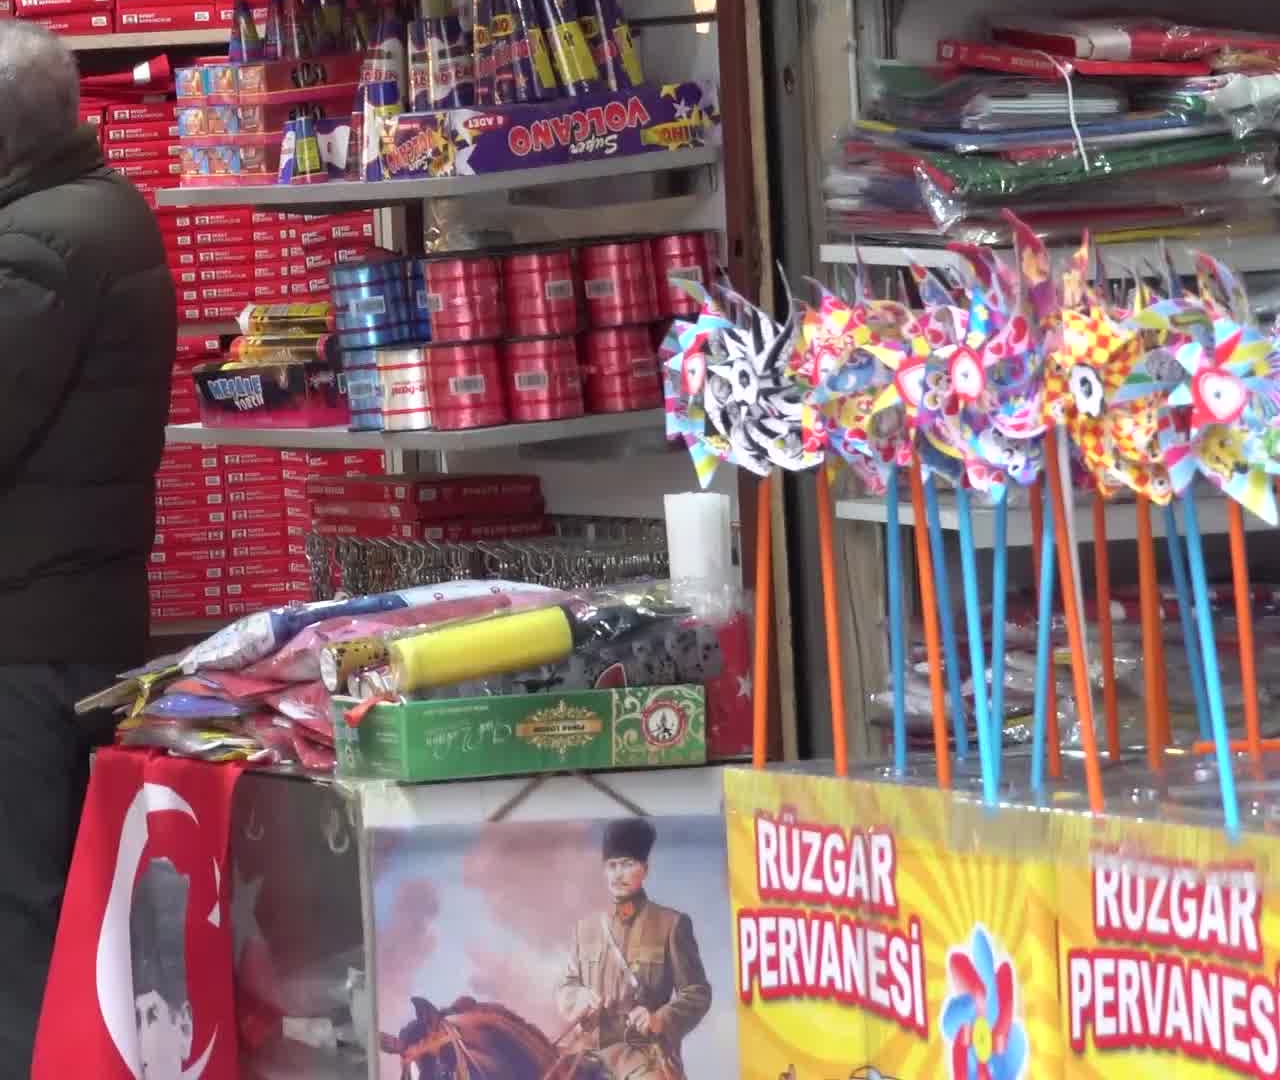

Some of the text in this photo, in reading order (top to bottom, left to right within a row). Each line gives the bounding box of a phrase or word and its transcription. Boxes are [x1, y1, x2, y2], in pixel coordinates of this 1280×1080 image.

[508, 96, 651, 157] VOLCANO
[569, 132, 619, 157] Super
[756, 810, 896, 908] RÜZGAR
[739, 916, 926, 1027] PERVANESİ
[1070, 956, 1280, 1076] PERVANES
